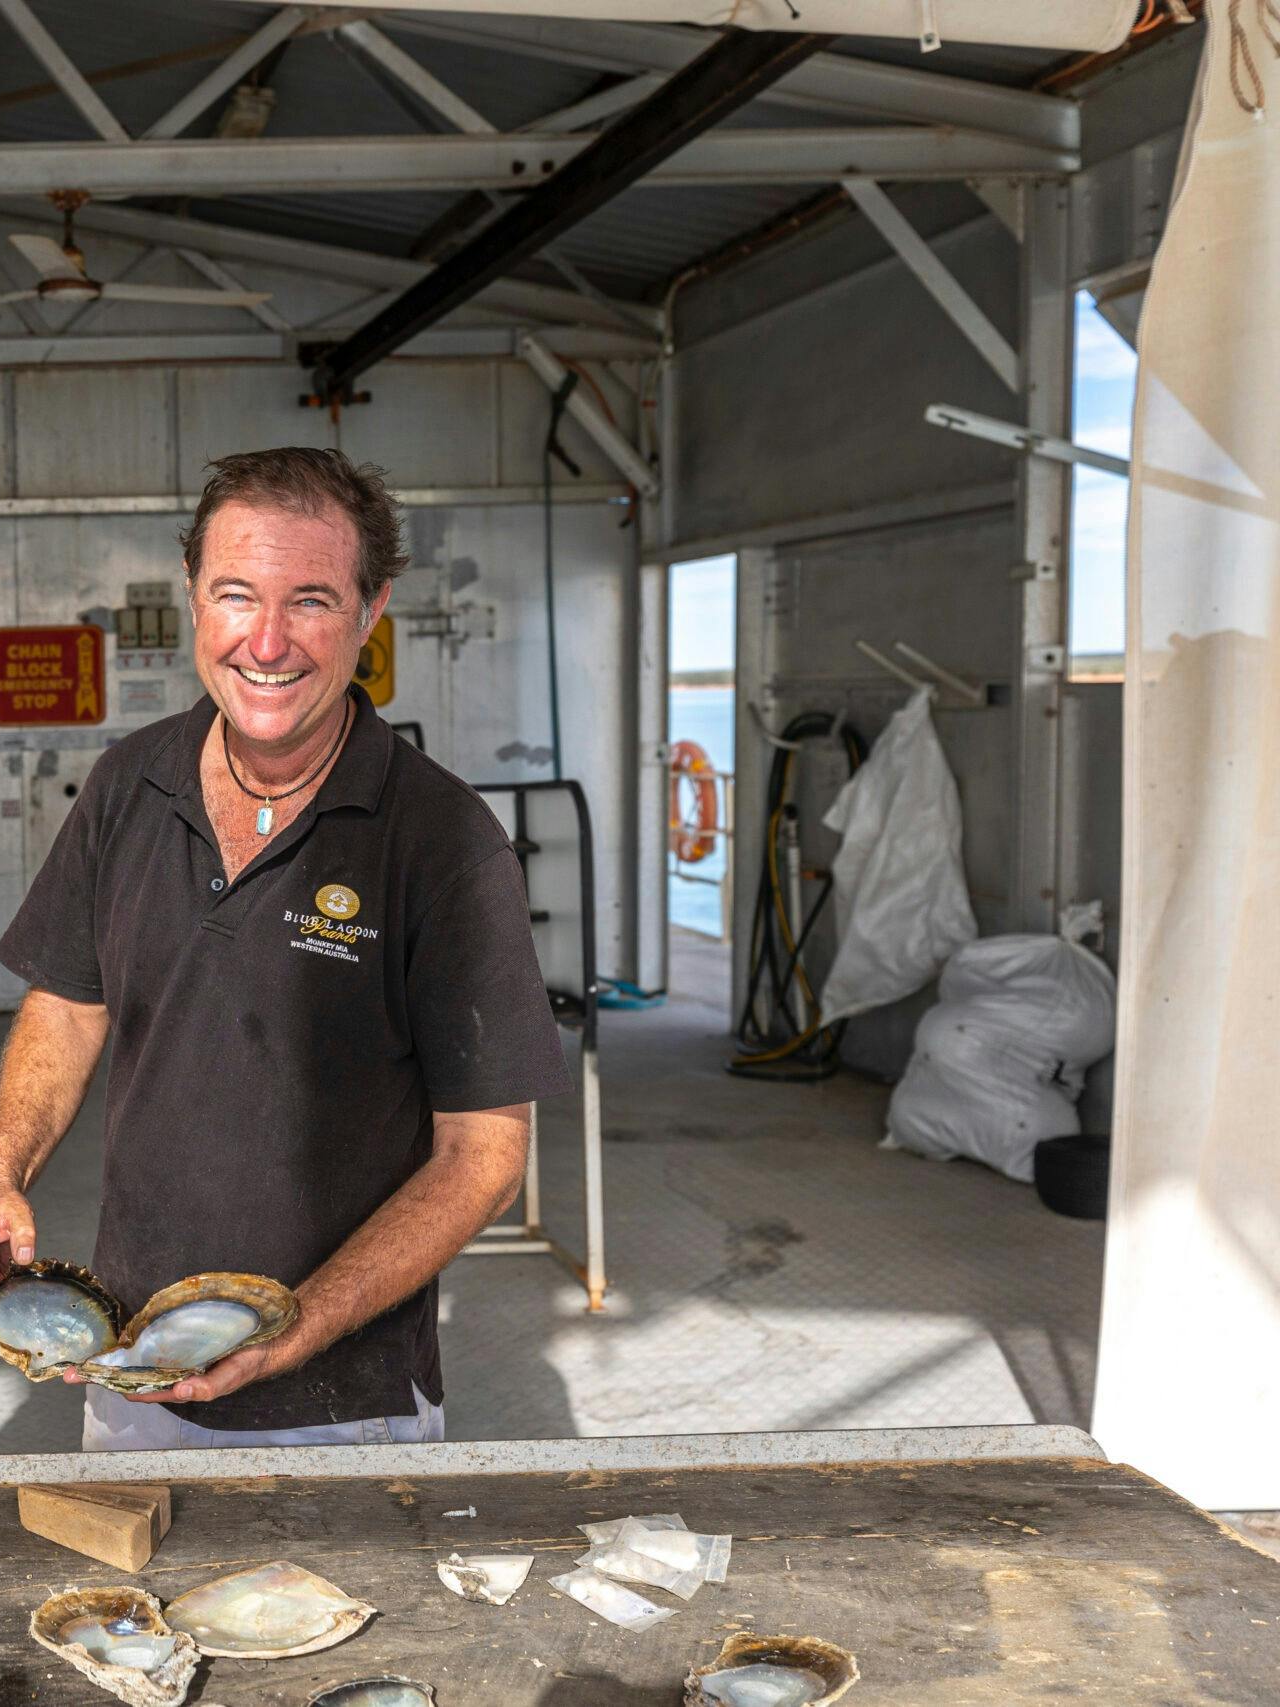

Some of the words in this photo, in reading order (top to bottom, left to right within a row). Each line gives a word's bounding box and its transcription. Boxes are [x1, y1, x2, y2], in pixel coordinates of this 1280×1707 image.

[7, 645, 62, 659] CHAIN
[6, 661, 62, 678] BLOCK
[11, 693, 59, 710] STOP
[283, 910, 319, 924] BLUE
[325, 919, 378, 938] LAGOON
[300, 916, 357, 943] Pearls
[290, 940, 324, 954] WESTERN
[323, 948, 359, 962] AUSTRALIA
[305, 937, 335, 949] MONKEY
[335, 943, 348, 953] MIA
